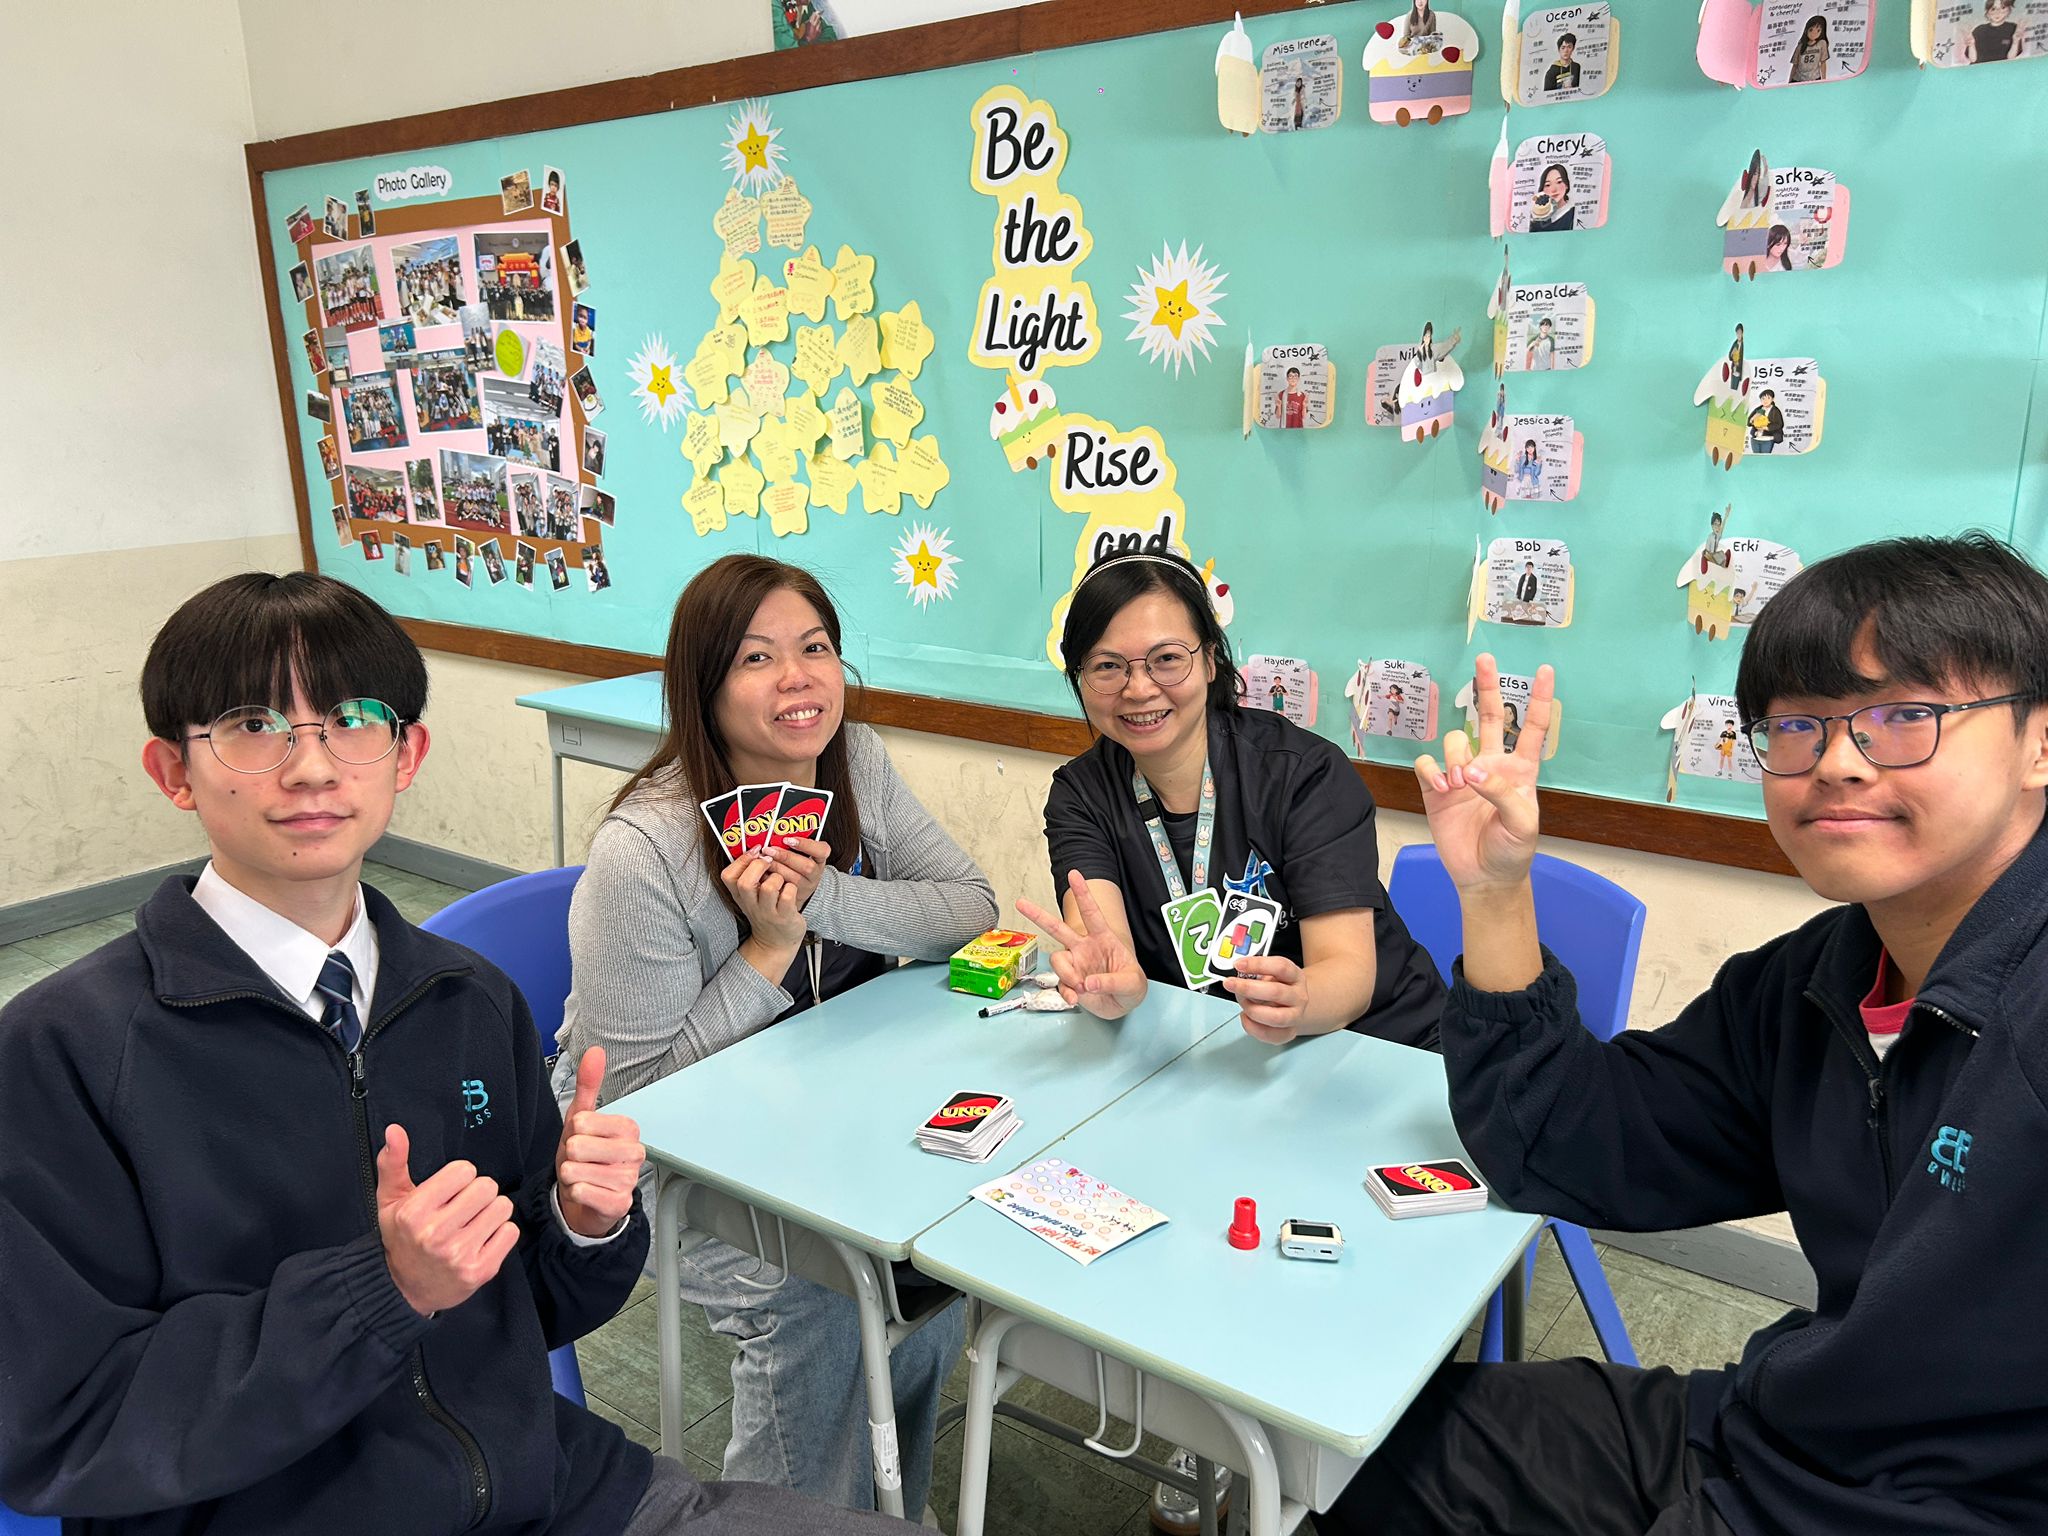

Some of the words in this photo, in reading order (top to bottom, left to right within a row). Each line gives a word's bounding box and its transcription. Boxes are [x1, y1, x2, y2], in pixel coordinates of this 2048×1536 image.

[1545, 7, 1582, 23] Ocean
[1272, 44, 1295, 55] Miss
[1297, 38, 1321, 50] Irene
[986, 106, 1054, 181] Be
[1537, 134, 1586, 156] Cheryl
[377, 176, 407, 193] Photo
[410, 172, 447, 190] Gallery
[1775, 167, 1814, 185] arka
[1003, 197, 1079, 264] the
[1515, 285, 1568, 302] Ronald
[984, 293, 1087, 372] Light
[1272, 346, 1314, 359] Carson
[1399, 347, 1418, 361] Nik
[1754, 364, 1784, 379] Isis
[1514, 415, 1550, 427] Jessica
[1065, 431, 1159, 490] Rise
[1093, 515, 1171, 562] and
[1515, 540, 1541, 552] Bob
[1733, 539, 1760, 552] Erki
[1264, 656, 1295, 668] Hayden
[1384, 660, 1405, 669] Suki
[1499, 676, 1529, 690] Elsa
[773, 811, 821, 837] UNO
[1170, 907, 1183, 922] 2
[939, 1105, 994, 1119] UNO
[1401, 1164, 1455, 1194] UNO
